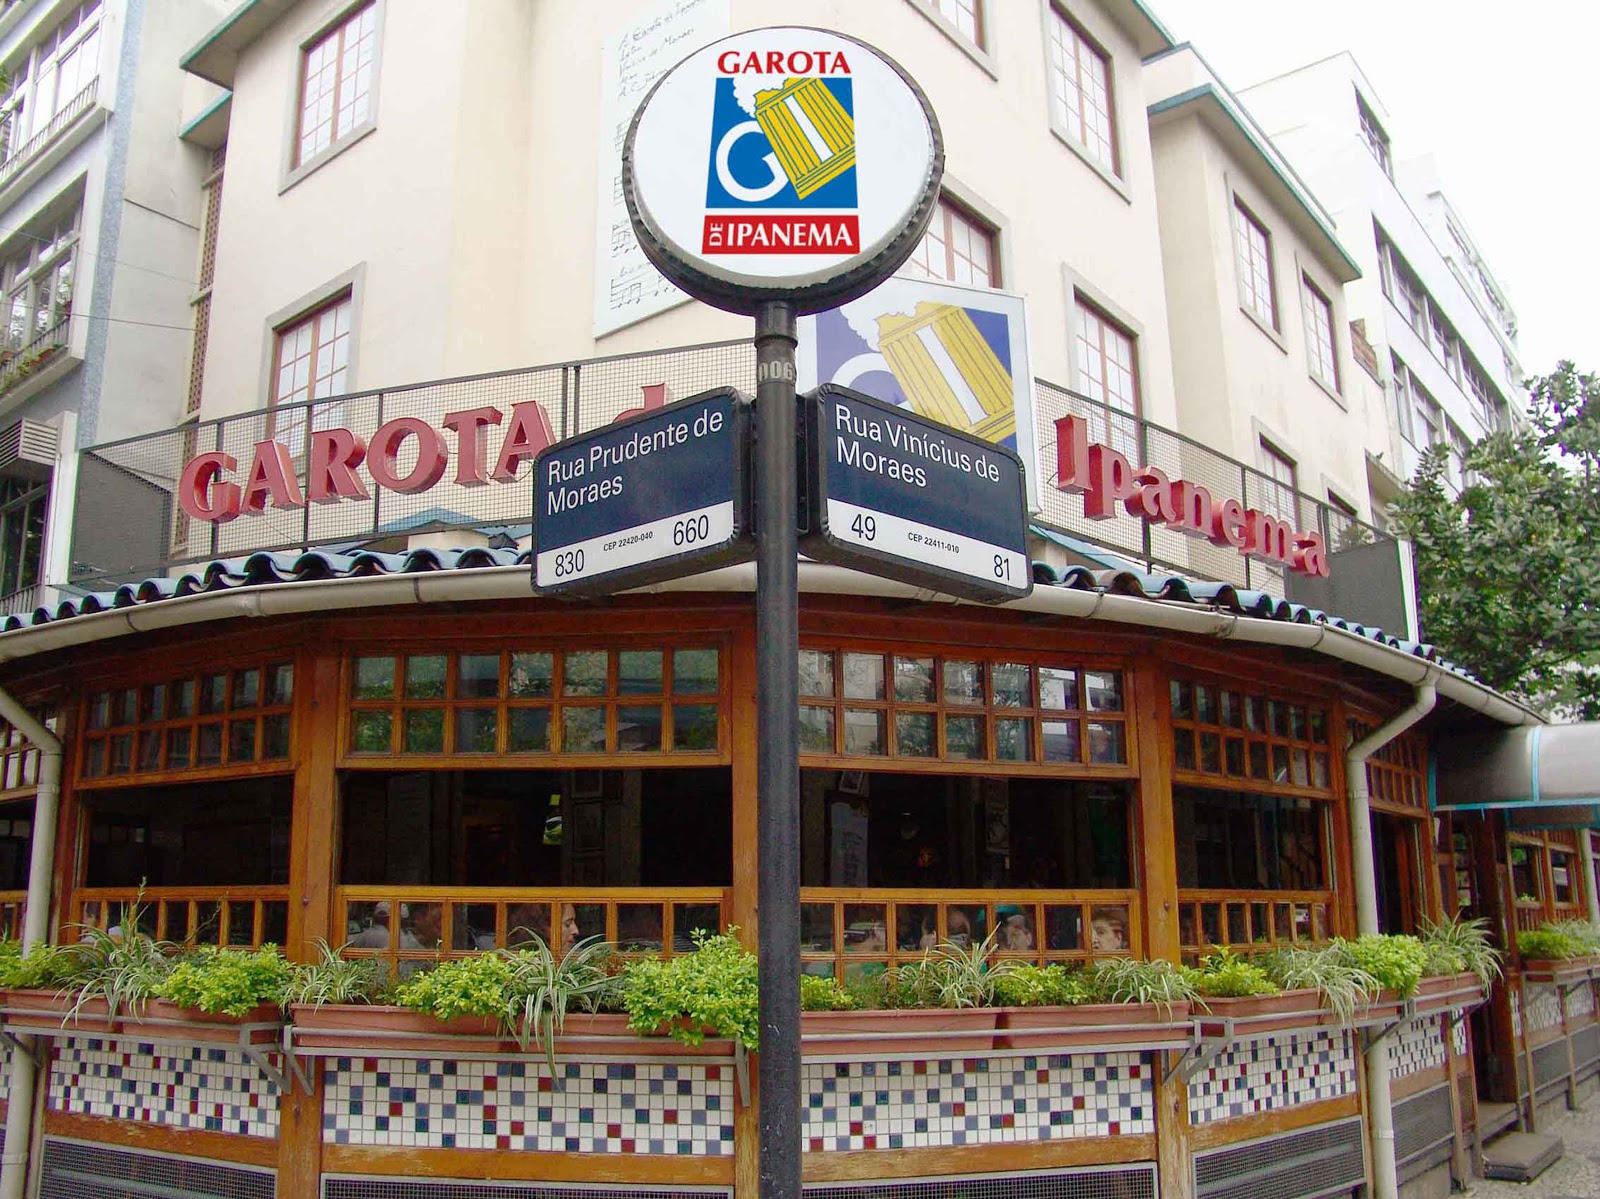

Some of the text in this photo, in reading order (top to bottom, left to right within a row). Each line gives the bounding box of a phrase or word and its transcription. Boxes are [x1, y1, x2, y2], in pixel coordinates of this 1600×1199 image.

[717, 51, 852, 75] GAROTA
[708, 222, 854, 247] DE IPANEMA
[547, 408, 724, 486] Rua Prudente de
[835, 403, 1000, 482] Rua Vinícius de
[178, 399, 556, 525] GAROTA
[836, 436, 927, 487] Moraes
[547, 475, 623, 516] Moraes
[1054, 413, 1331, 578] Ipanema
[603, 531, 654, 552] CEP 22420-040
[673, 514, 709, 546] 660
[851, 513, 877, 541] 49
[908, 531, 960, 554] CEP 22411-010
[555, 549, 585, 578] 830
[993, 554, 1011, 581] 81
